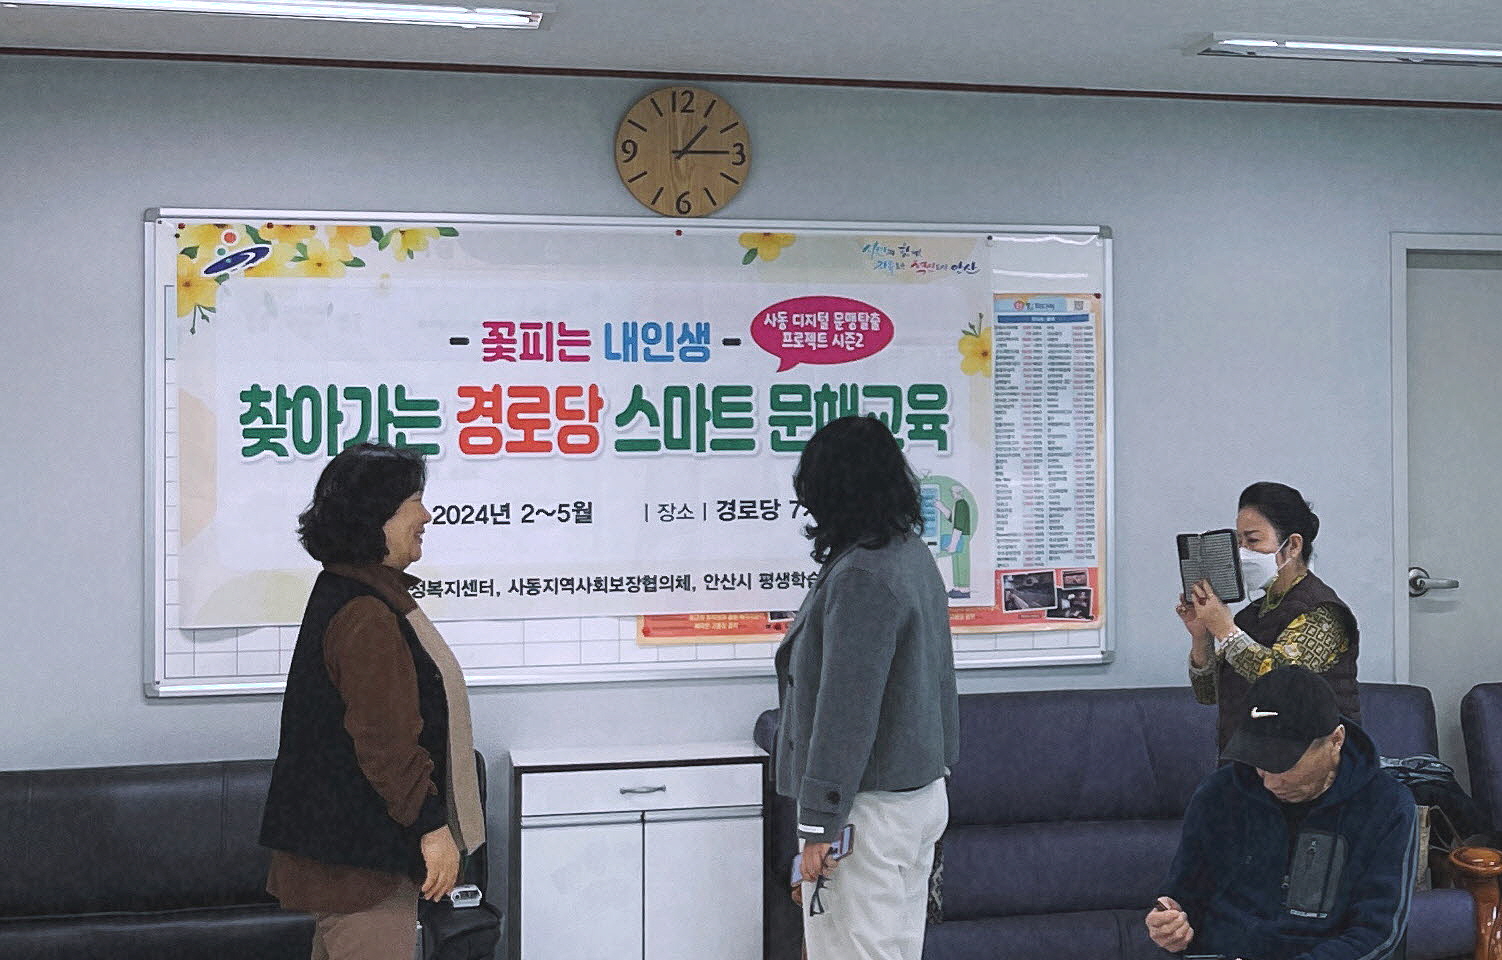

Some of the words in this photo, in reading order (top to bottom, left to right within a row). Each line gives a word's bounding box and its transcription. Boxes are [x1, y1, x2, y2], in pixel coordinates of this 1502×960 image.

[671, 90, 695, 113] 12
[621, 139, 638, 163] 9
[731, 142, 746, 166] 3
[675, 191, 692, 214] 6
[763, 311, 788, 330] 사동
[791, 311, 829, 331] 디지털
[482, 321, 592, 362] 꽃피는
[604, 321, 711, 362] 내인생
[781, 331, 828, 350] 프로젝트
[831, 332, 864, 350] 시즌2
[239, 383, 442, 457] 찾아가는
[456, 383, 604, 454] 경로당
[614, 382, 756, 452] 스마트
[432, 502, 511, 525] 2024년
[521, 501, 593, 524] 2~5월
[657, 503, 695, 522] 장소
[716, 498, 781, 521] 경로당
[508, 574, 696, 596] 사동지역사회보장협의체,
[703, 571, 751, 591] 안산시
